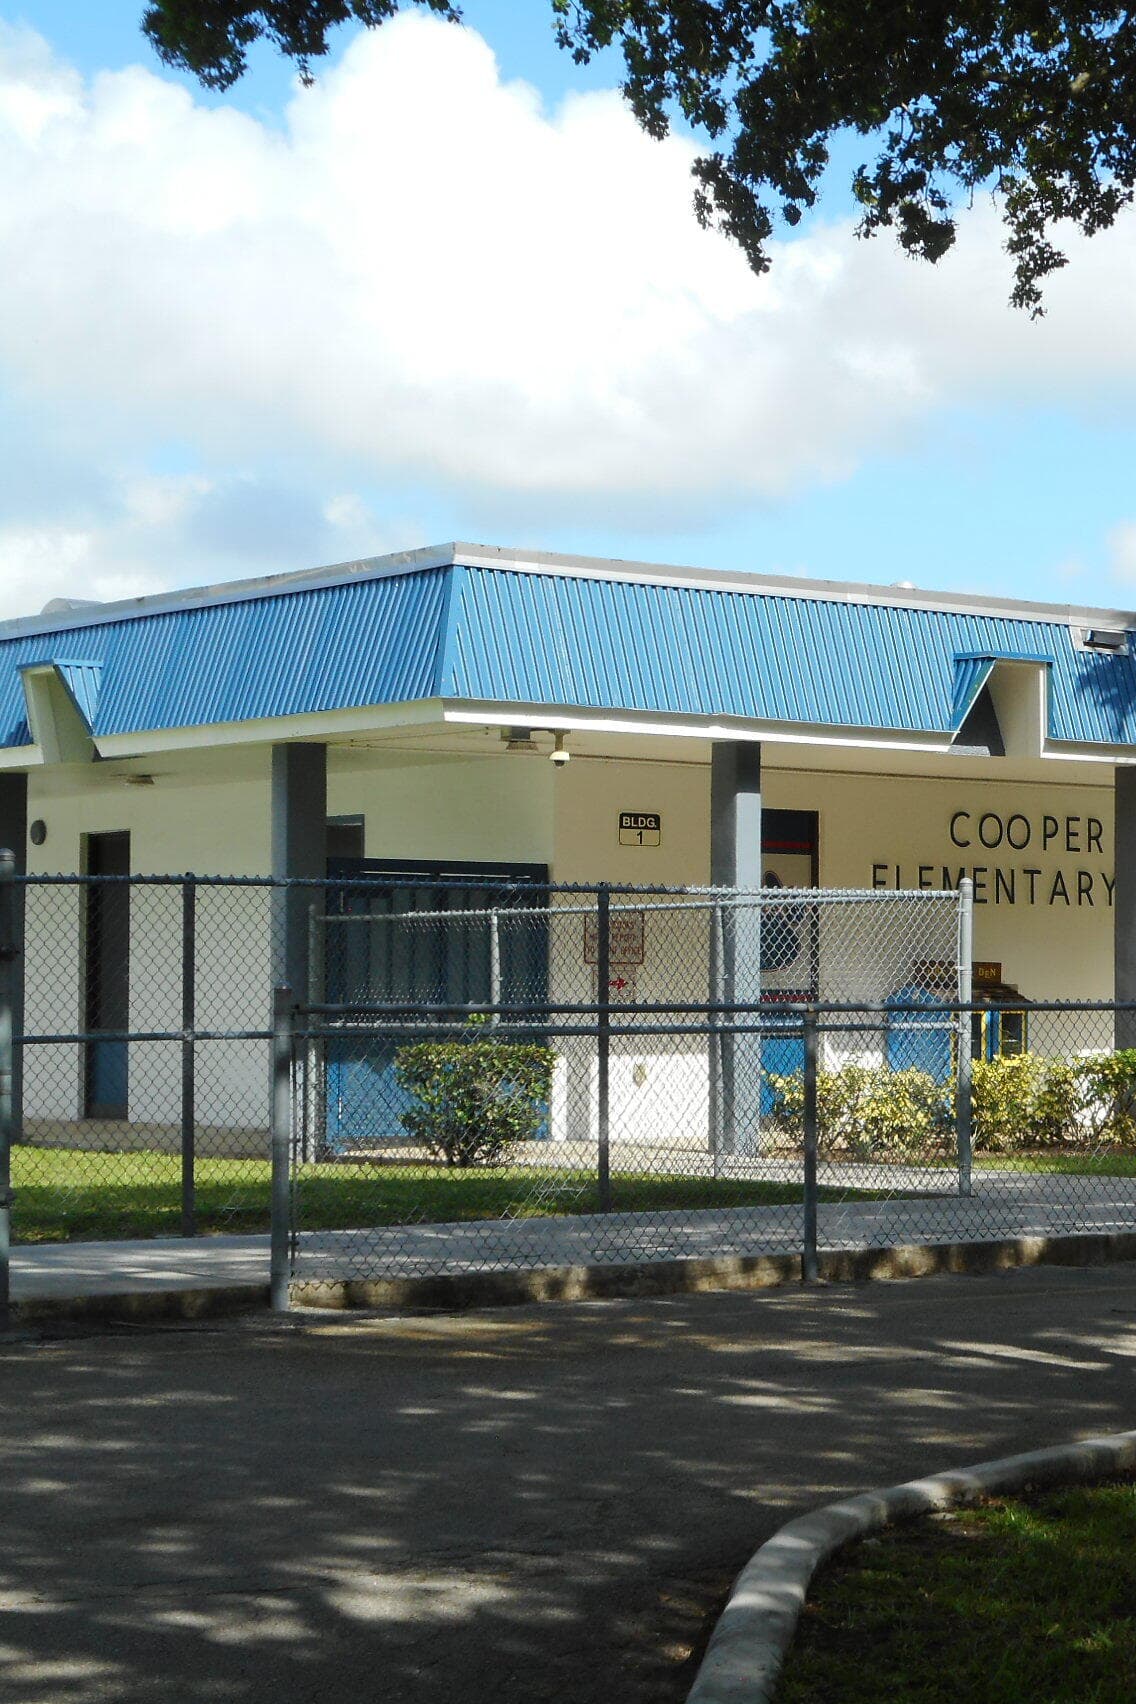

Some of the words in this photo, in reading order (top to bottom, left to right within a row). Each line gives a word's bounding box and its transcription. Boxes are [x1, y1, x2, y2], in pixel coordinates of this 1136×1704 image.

[622, 816, 657, 828] BLDG.
[949, 811, 1104, 854] COOPER
[636, 830, 643, 845] 1
[872, 864, 1116, 907] ELEMENTARY
